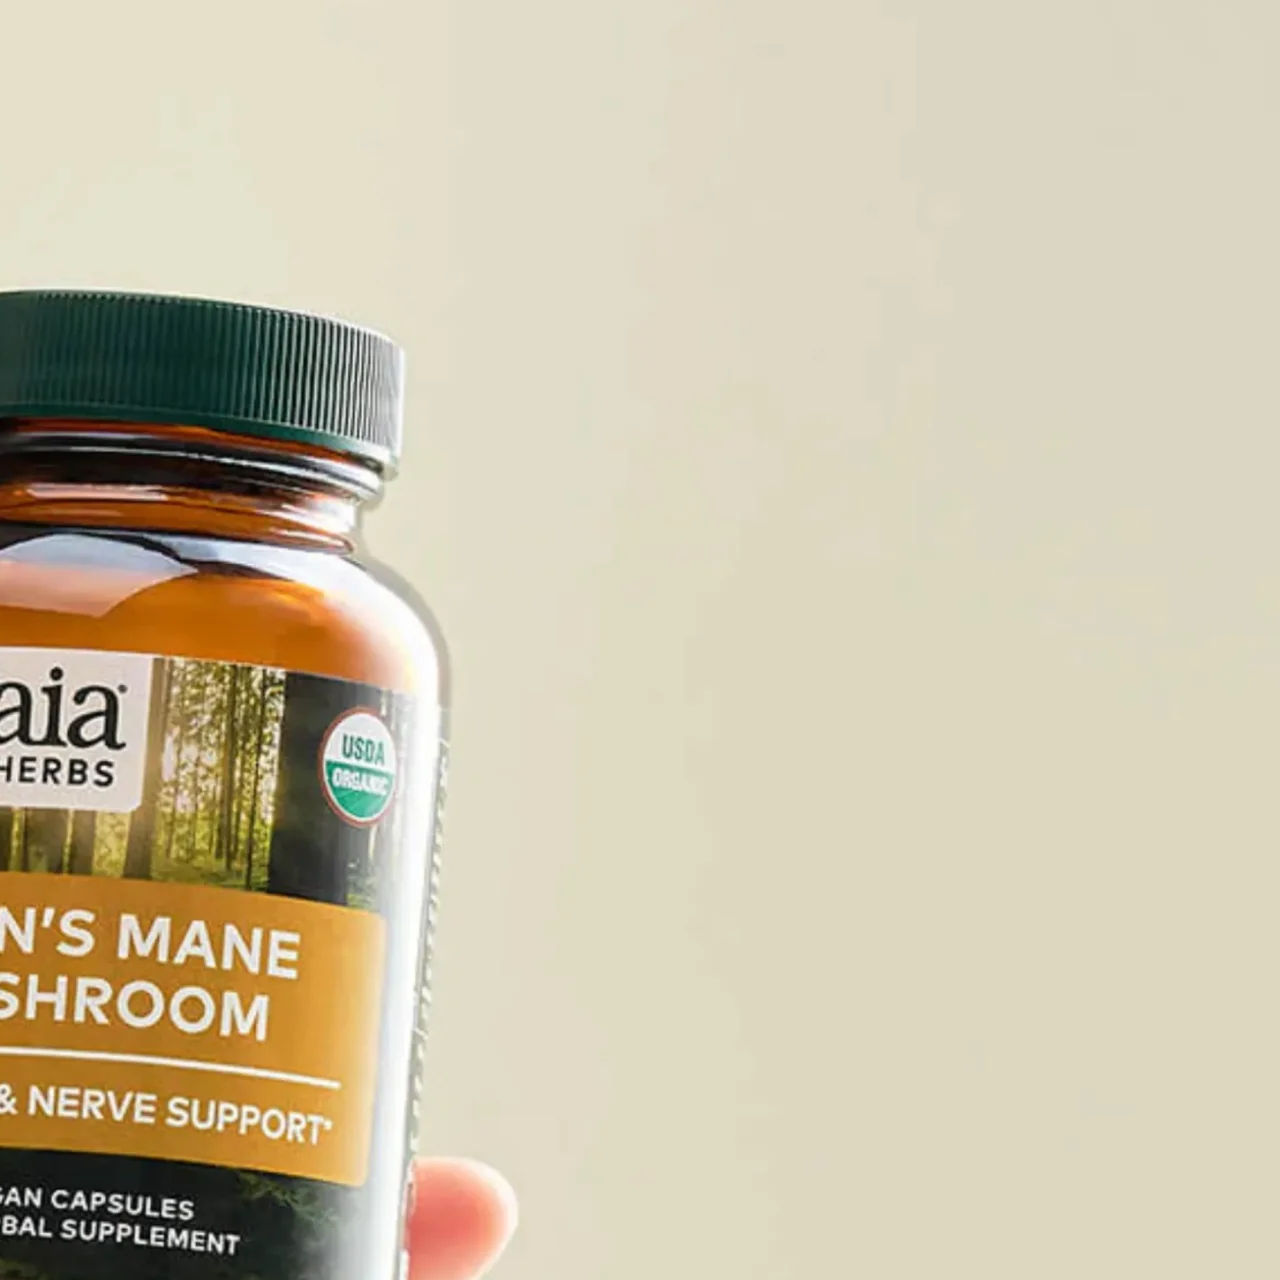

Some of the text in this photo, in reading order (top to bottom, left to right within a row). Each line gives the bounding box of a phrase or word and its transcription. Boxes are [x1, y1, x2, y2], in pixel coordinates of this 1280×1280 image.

[342, 733, 385, 766] USDA
[118, 913, 301, 979] MANE
[28, 1086, 156, 1124] NERVE
[51, 1189, 195, 1221] CAPSULES
[61, 1218, 240, 1255] SUPPLEMENT
